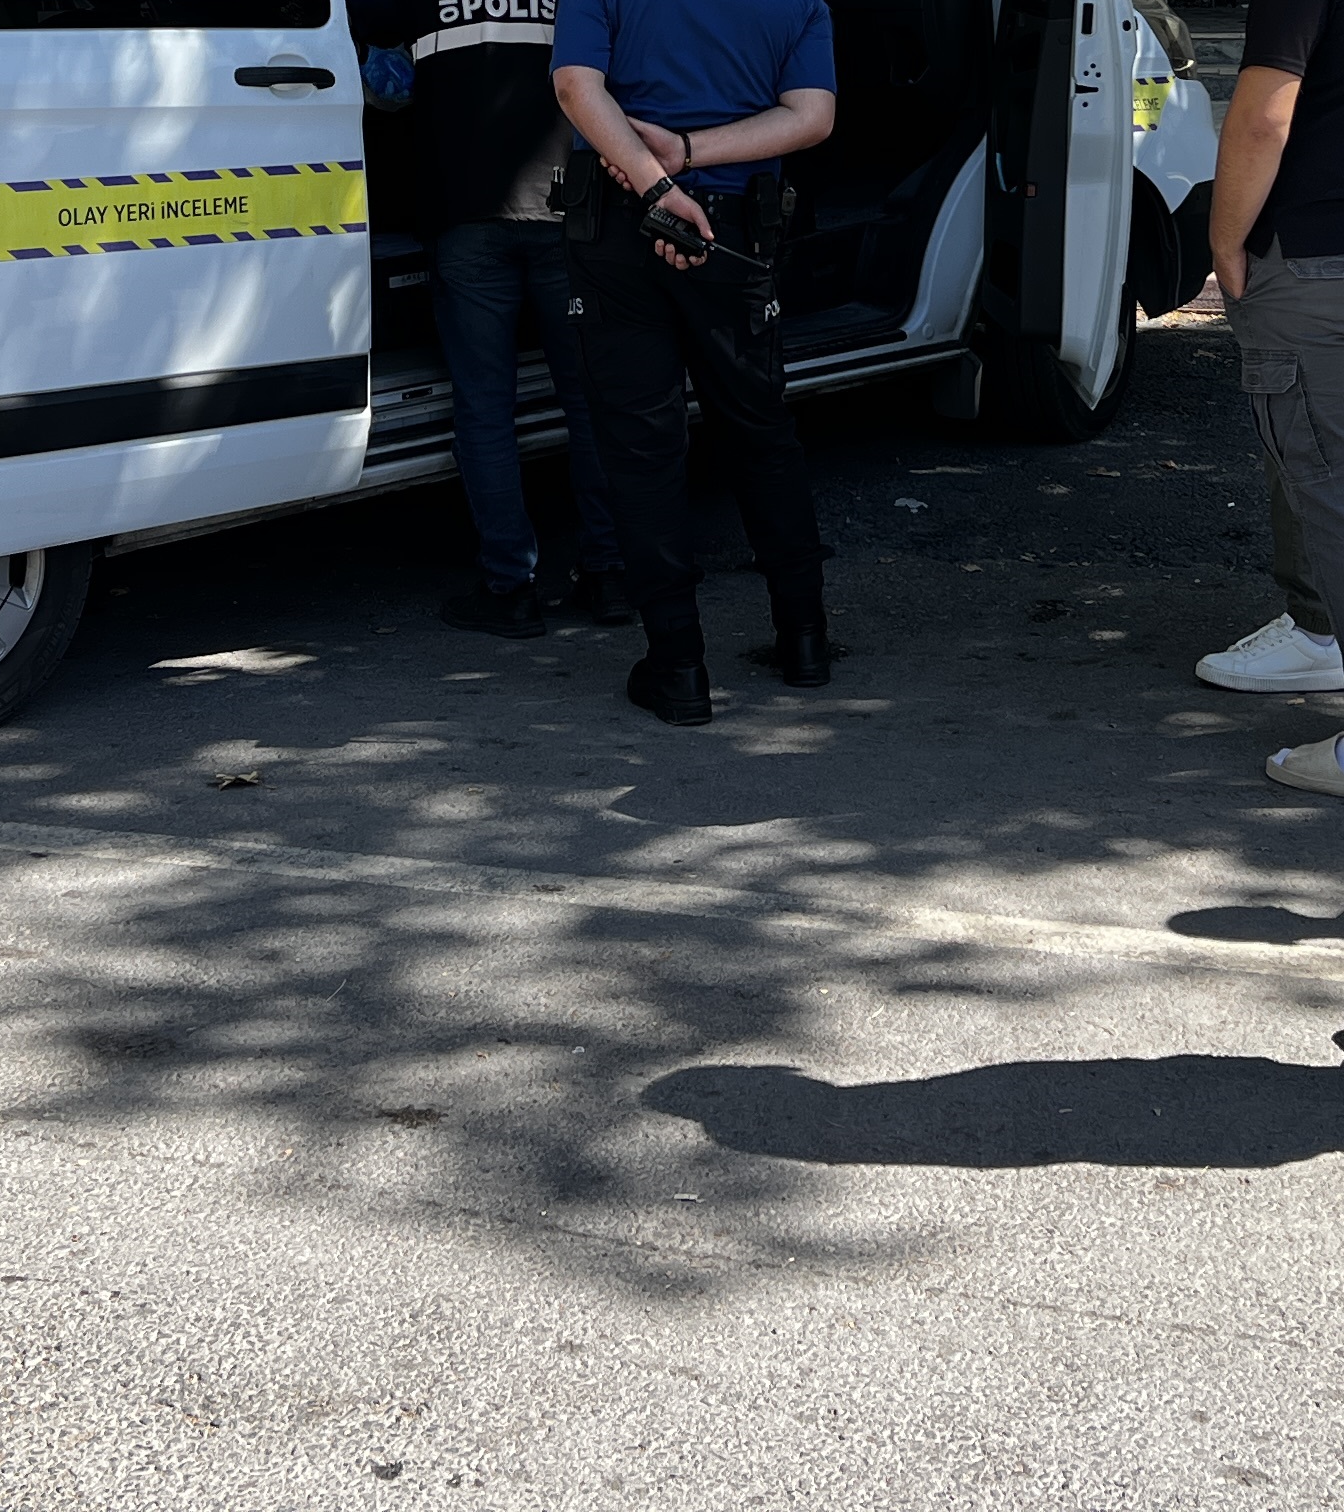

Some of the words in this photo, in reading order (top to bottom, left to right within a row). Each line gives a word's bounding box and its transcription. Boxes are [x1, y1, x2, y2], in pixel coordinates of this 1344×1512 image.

[58, 205, 108, 226] OLAY
[113, 202, 155, 223] YERİ
[160, 195, 249, 220] İNCELEME
